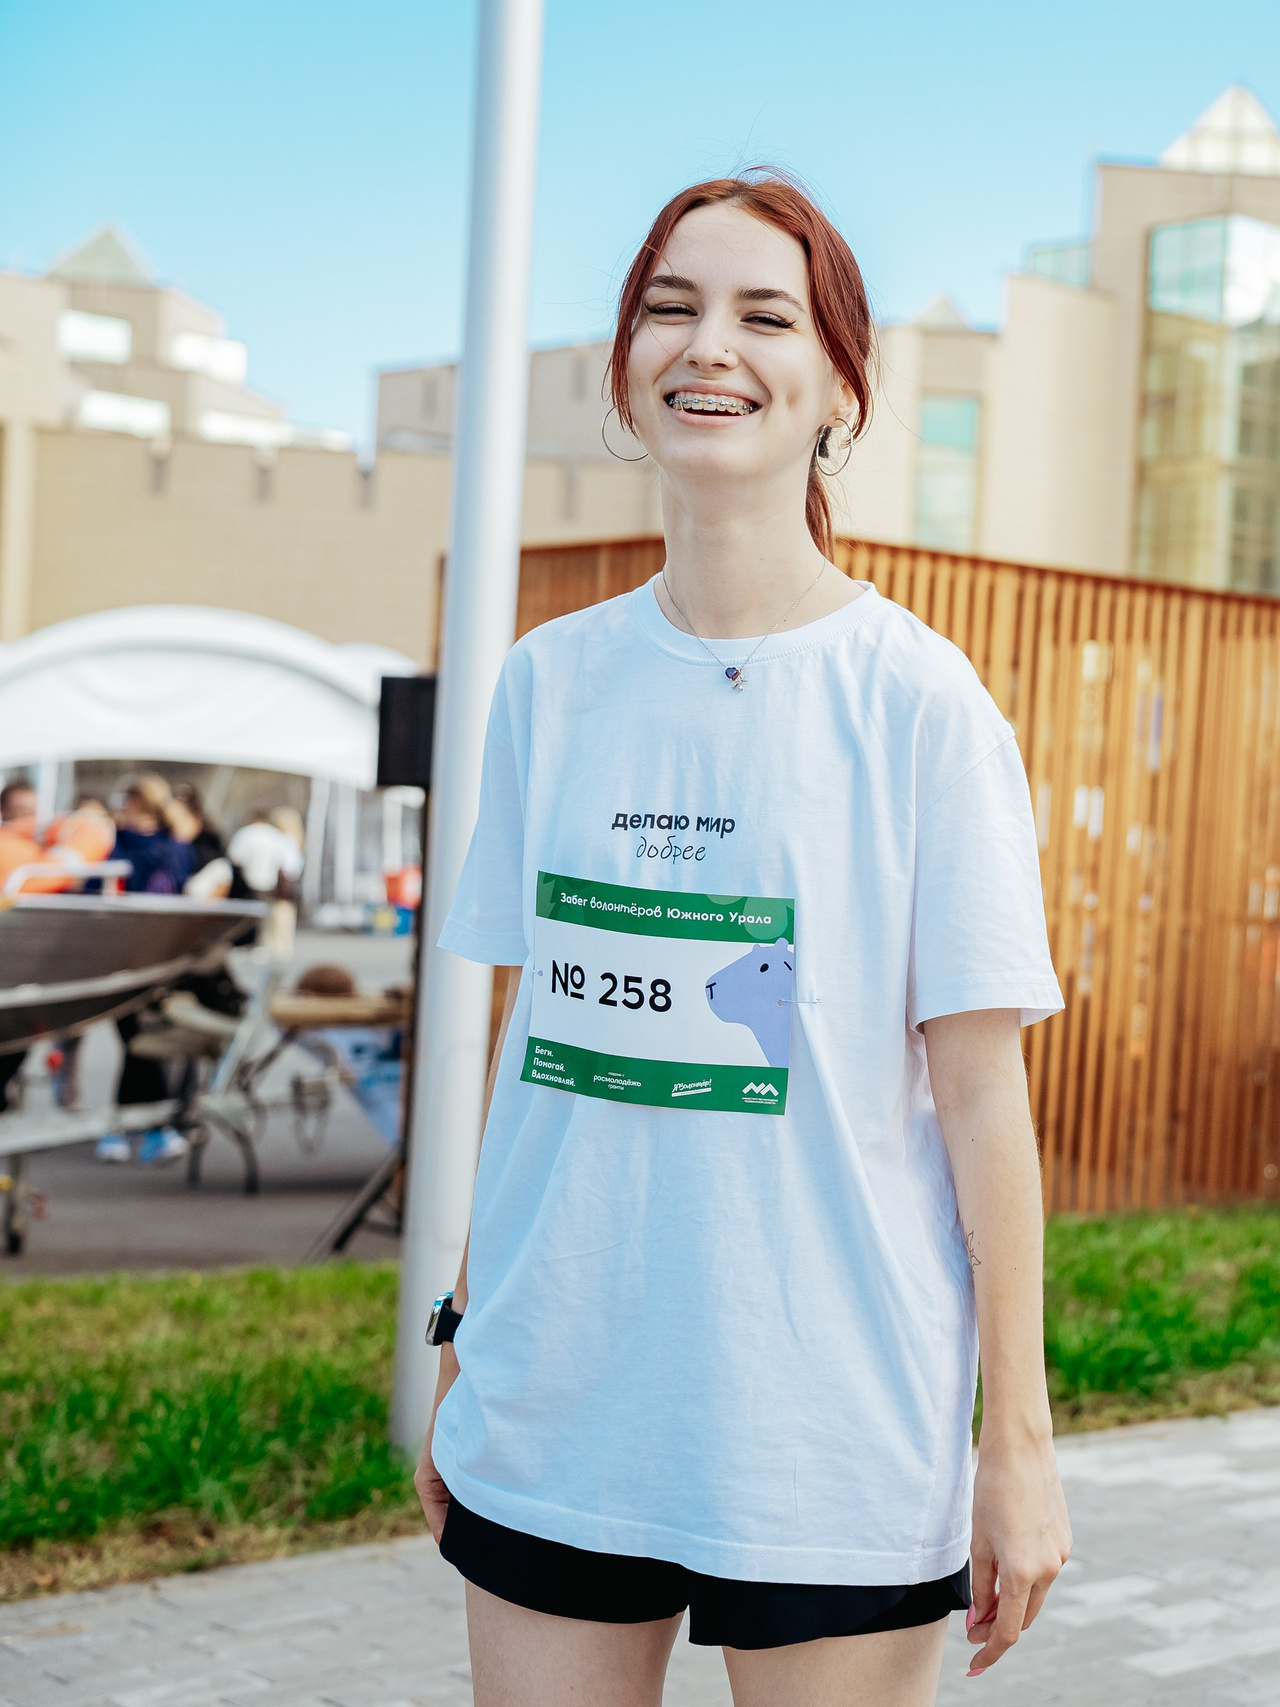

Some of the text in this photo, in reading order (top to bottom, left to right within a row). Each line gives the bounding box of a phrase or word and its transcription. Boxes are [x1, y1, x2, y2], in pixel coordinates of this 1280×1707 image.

[611, 812, 736, 839] делаю мир
[635, 834, 707, 865] добрее
[560, 892, 772, 926] Забег волонтёров Южного Урала
[551, 959, 672, 1013] № 258
[533, 1057, 566, 1072] Помогай.
[534, 1045, 554, 1058] Беги.
[531, 1069, 576, 1087] Вдохновляй.
